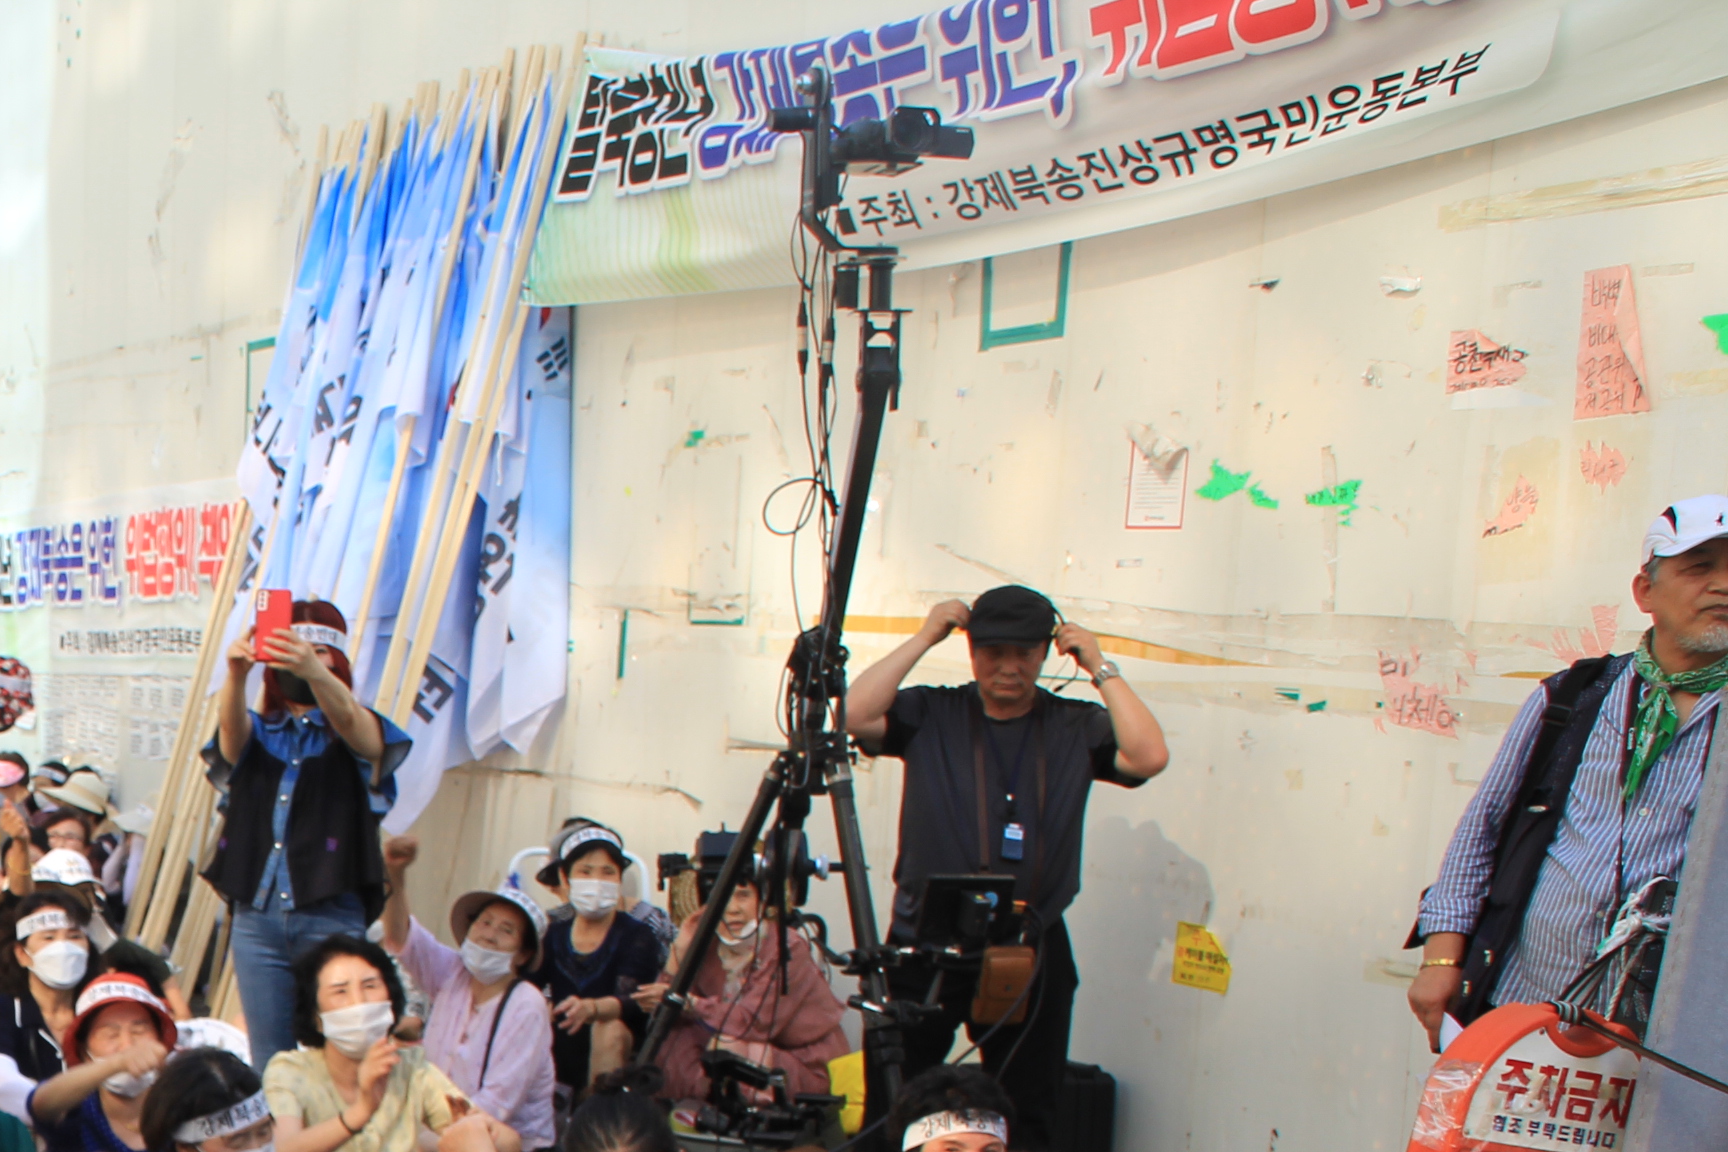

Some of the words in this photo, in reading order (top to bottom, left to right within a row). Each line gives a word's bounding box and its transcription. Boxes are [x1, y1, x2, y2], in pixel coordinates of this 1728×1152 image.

[858, 187, 924, 237] 주최
[942, 43, 1493, 222] 강제북송진상규명국민운동본부
[1495, 1058, 1637, 1130] 주차금지
[1492, 1114, 1522, 1134] 협조
[1528, 1119, 1616, 1149] 부탁드립니다
